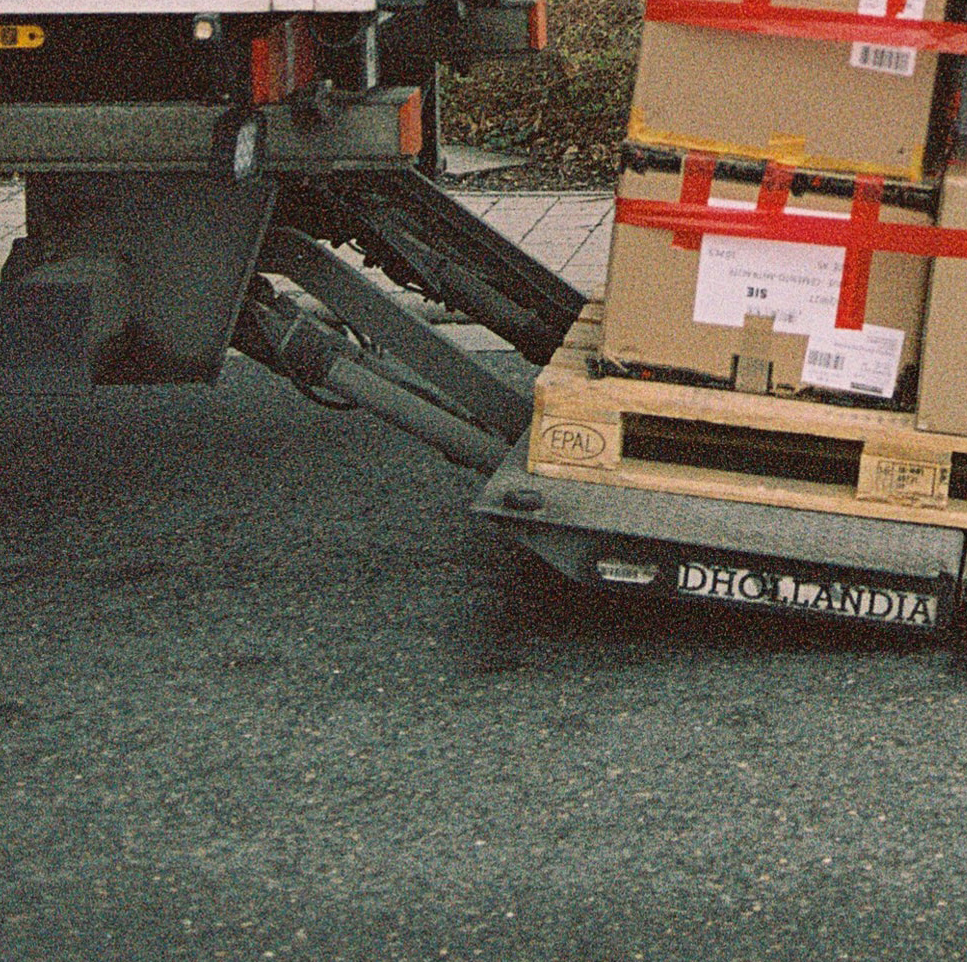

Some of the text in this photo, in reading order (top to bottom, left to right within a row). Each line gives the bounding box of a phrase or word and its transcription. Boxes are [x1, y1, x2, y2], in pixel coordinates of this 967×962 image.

[746, 286, 768, 299] SIE
[550, 428, 596, 453] EPAL
[679, 563, 935, 625] DHOLLANDIA
